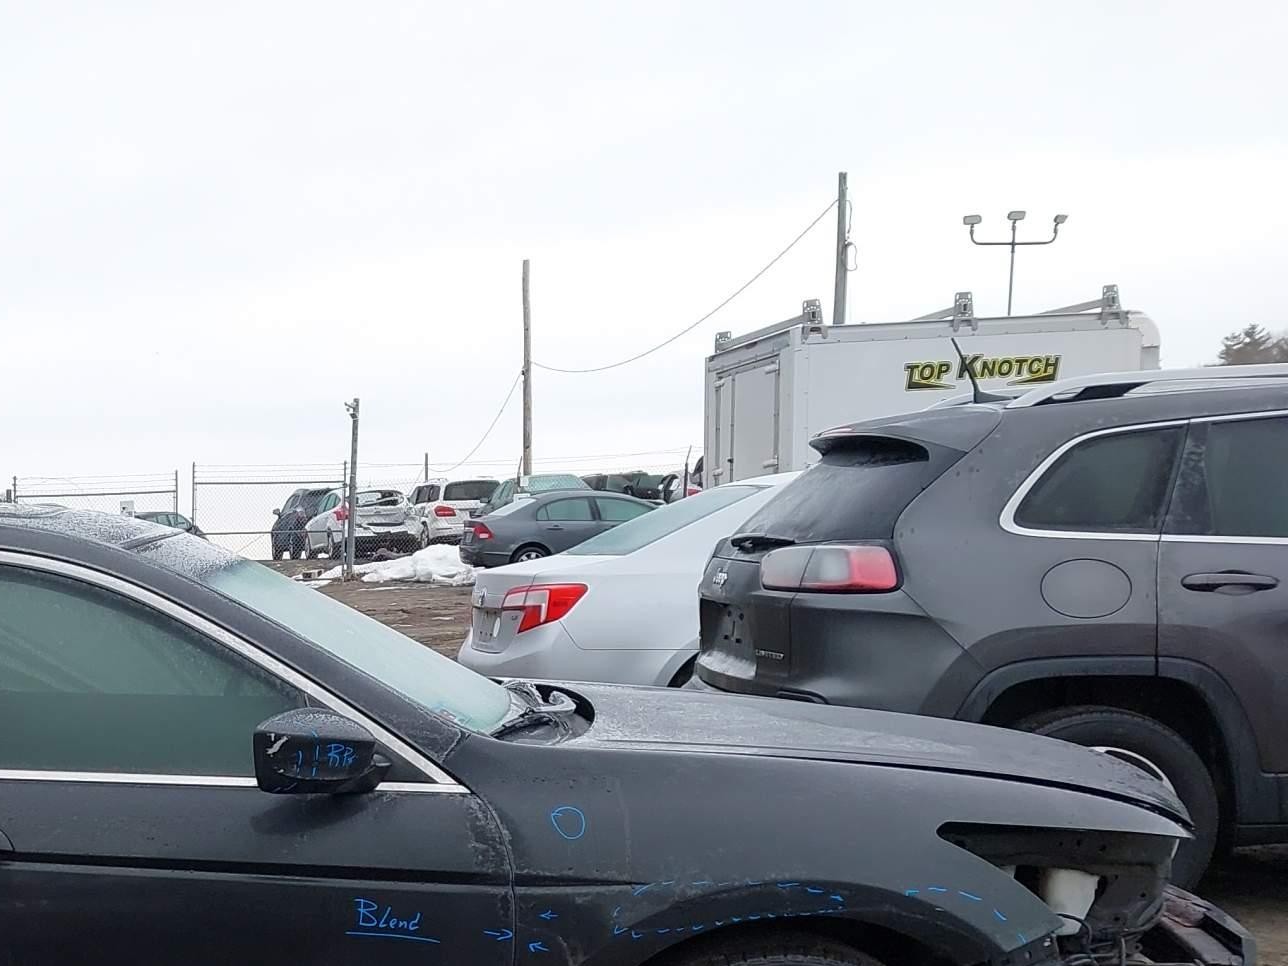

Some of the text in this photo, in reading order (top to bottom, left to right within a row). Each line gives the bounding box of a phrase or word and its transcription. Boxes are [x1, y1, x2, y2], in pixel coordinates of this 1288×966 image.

[904, 353, 1061, 390] TOP KNOTCH
[354, 898, 421, 931] Blend
